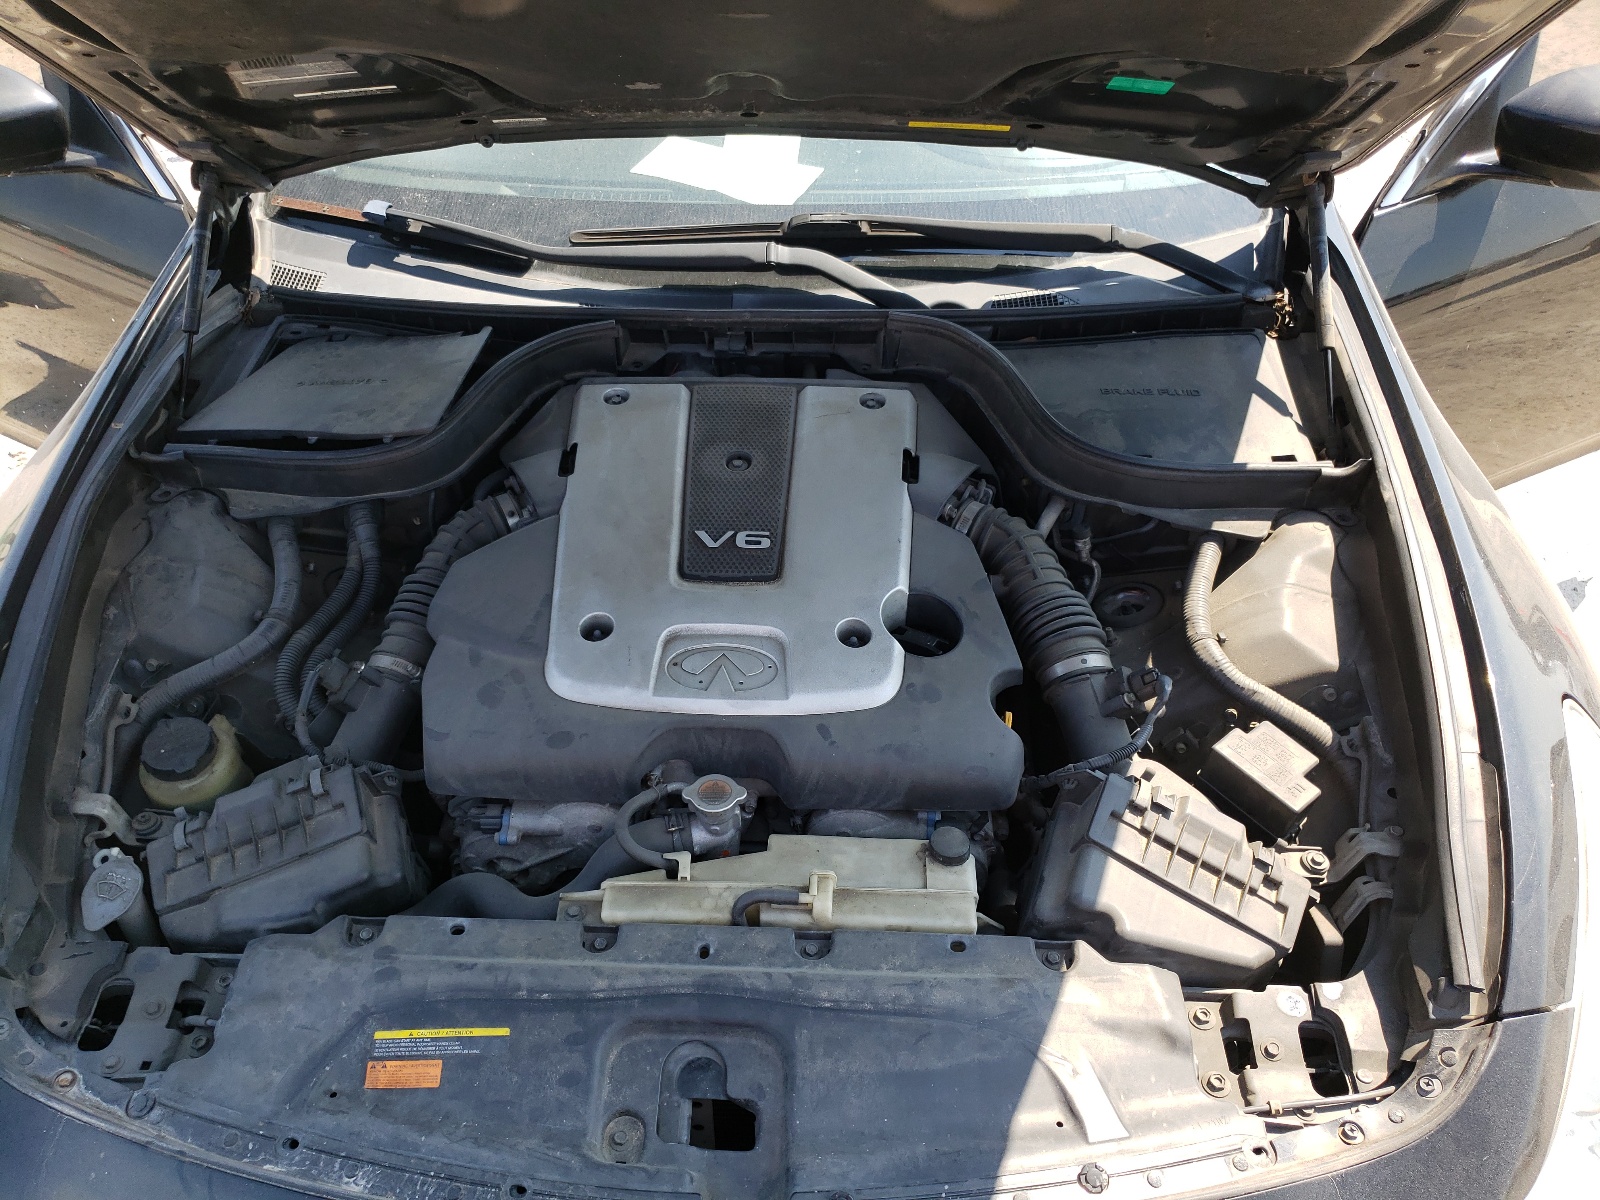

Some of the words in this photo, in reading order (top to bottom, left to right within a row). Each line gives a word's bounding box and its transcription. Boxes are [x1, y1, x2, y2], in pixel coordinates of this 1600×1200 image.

[1099, 387, 1154, 396] BRAKE
[1157, 388, 1201, 397] FLUID
[694, 530, 771, 549] V6
